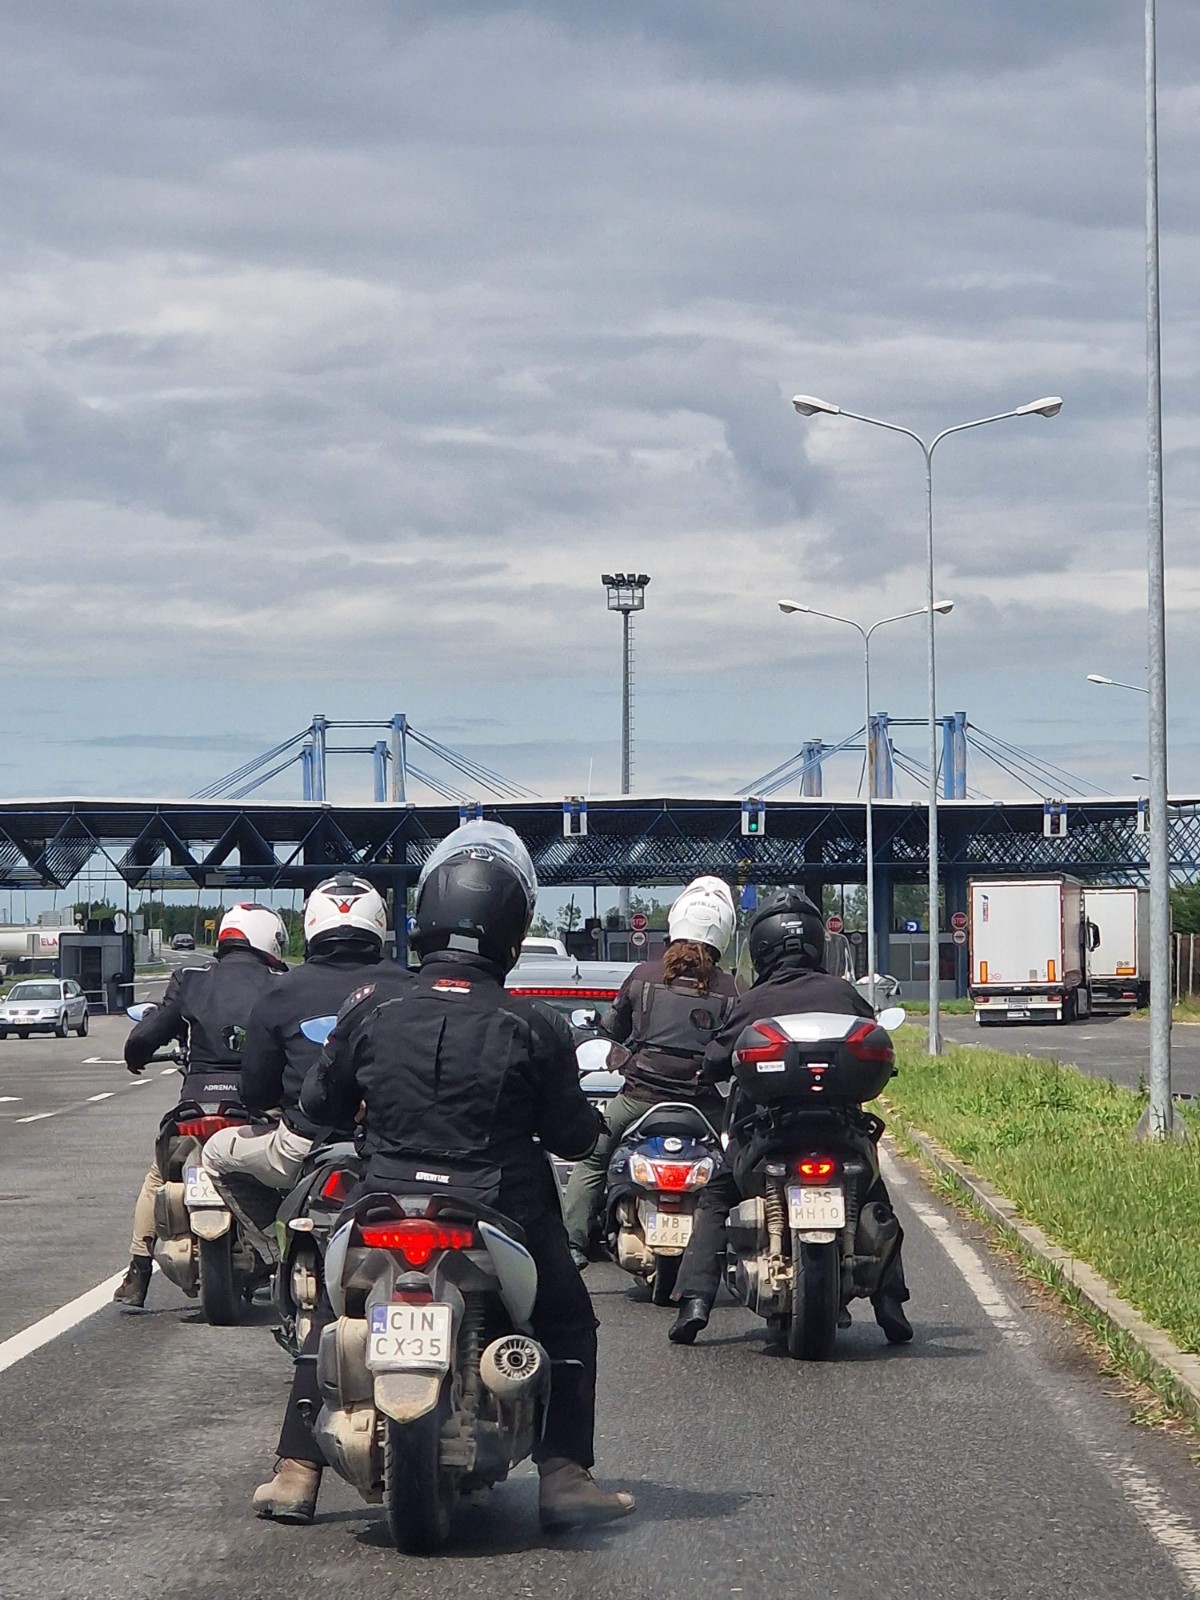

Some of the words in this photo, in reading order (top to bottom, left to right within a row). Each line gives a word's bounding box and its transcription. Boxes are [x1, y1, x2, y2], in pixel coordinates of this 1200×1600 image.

[803, 1191, 832, 1203] SPS
[661, 1217, 680, 1229] WB
[372, 1322, 386, 1332] PL
[390, 1311, 435, 1331] CIN
[375, 1337, 442, 1357] CX35
